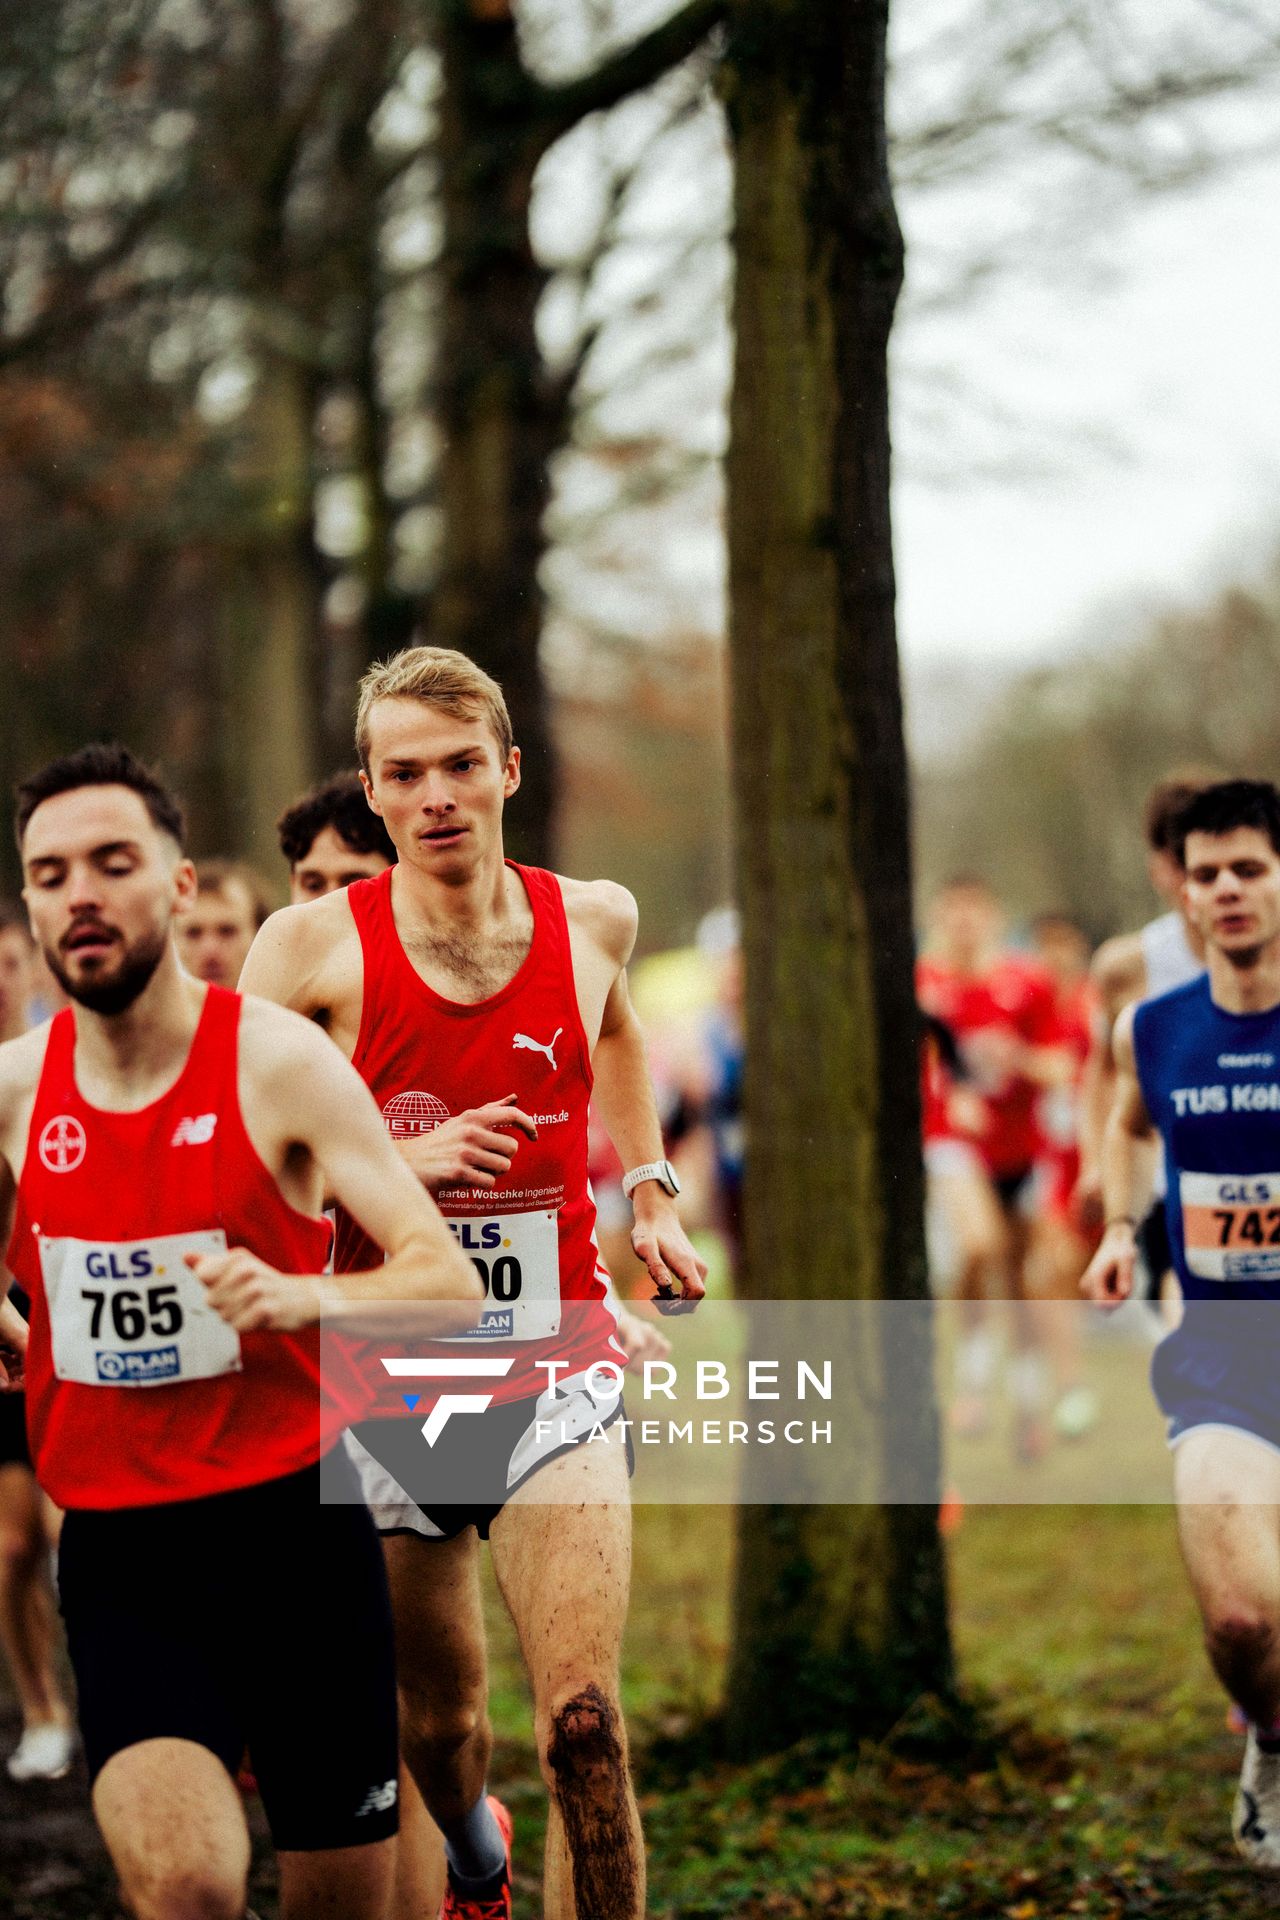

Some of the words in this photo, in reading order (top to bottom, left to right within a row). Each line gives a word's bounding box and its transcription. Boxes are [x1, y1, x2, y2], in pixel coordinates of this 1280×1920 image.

[1170, 1085, 1228, 1116] TUS
[1232, 1083, 1280, 1112] Köl
[528, 1109, 569, 1125] tens.de
[438, 1189, 470, 1199] Bartei
[472, 1189, 524, 1199] Wotschke
[1212, 1209, 1280, 1246] 742
[81, 1284, 183, 1342] 765
[466, 1324, 510, 1335] INTERNATIONAL
[125, 1350, 177, 1373] PLAN
